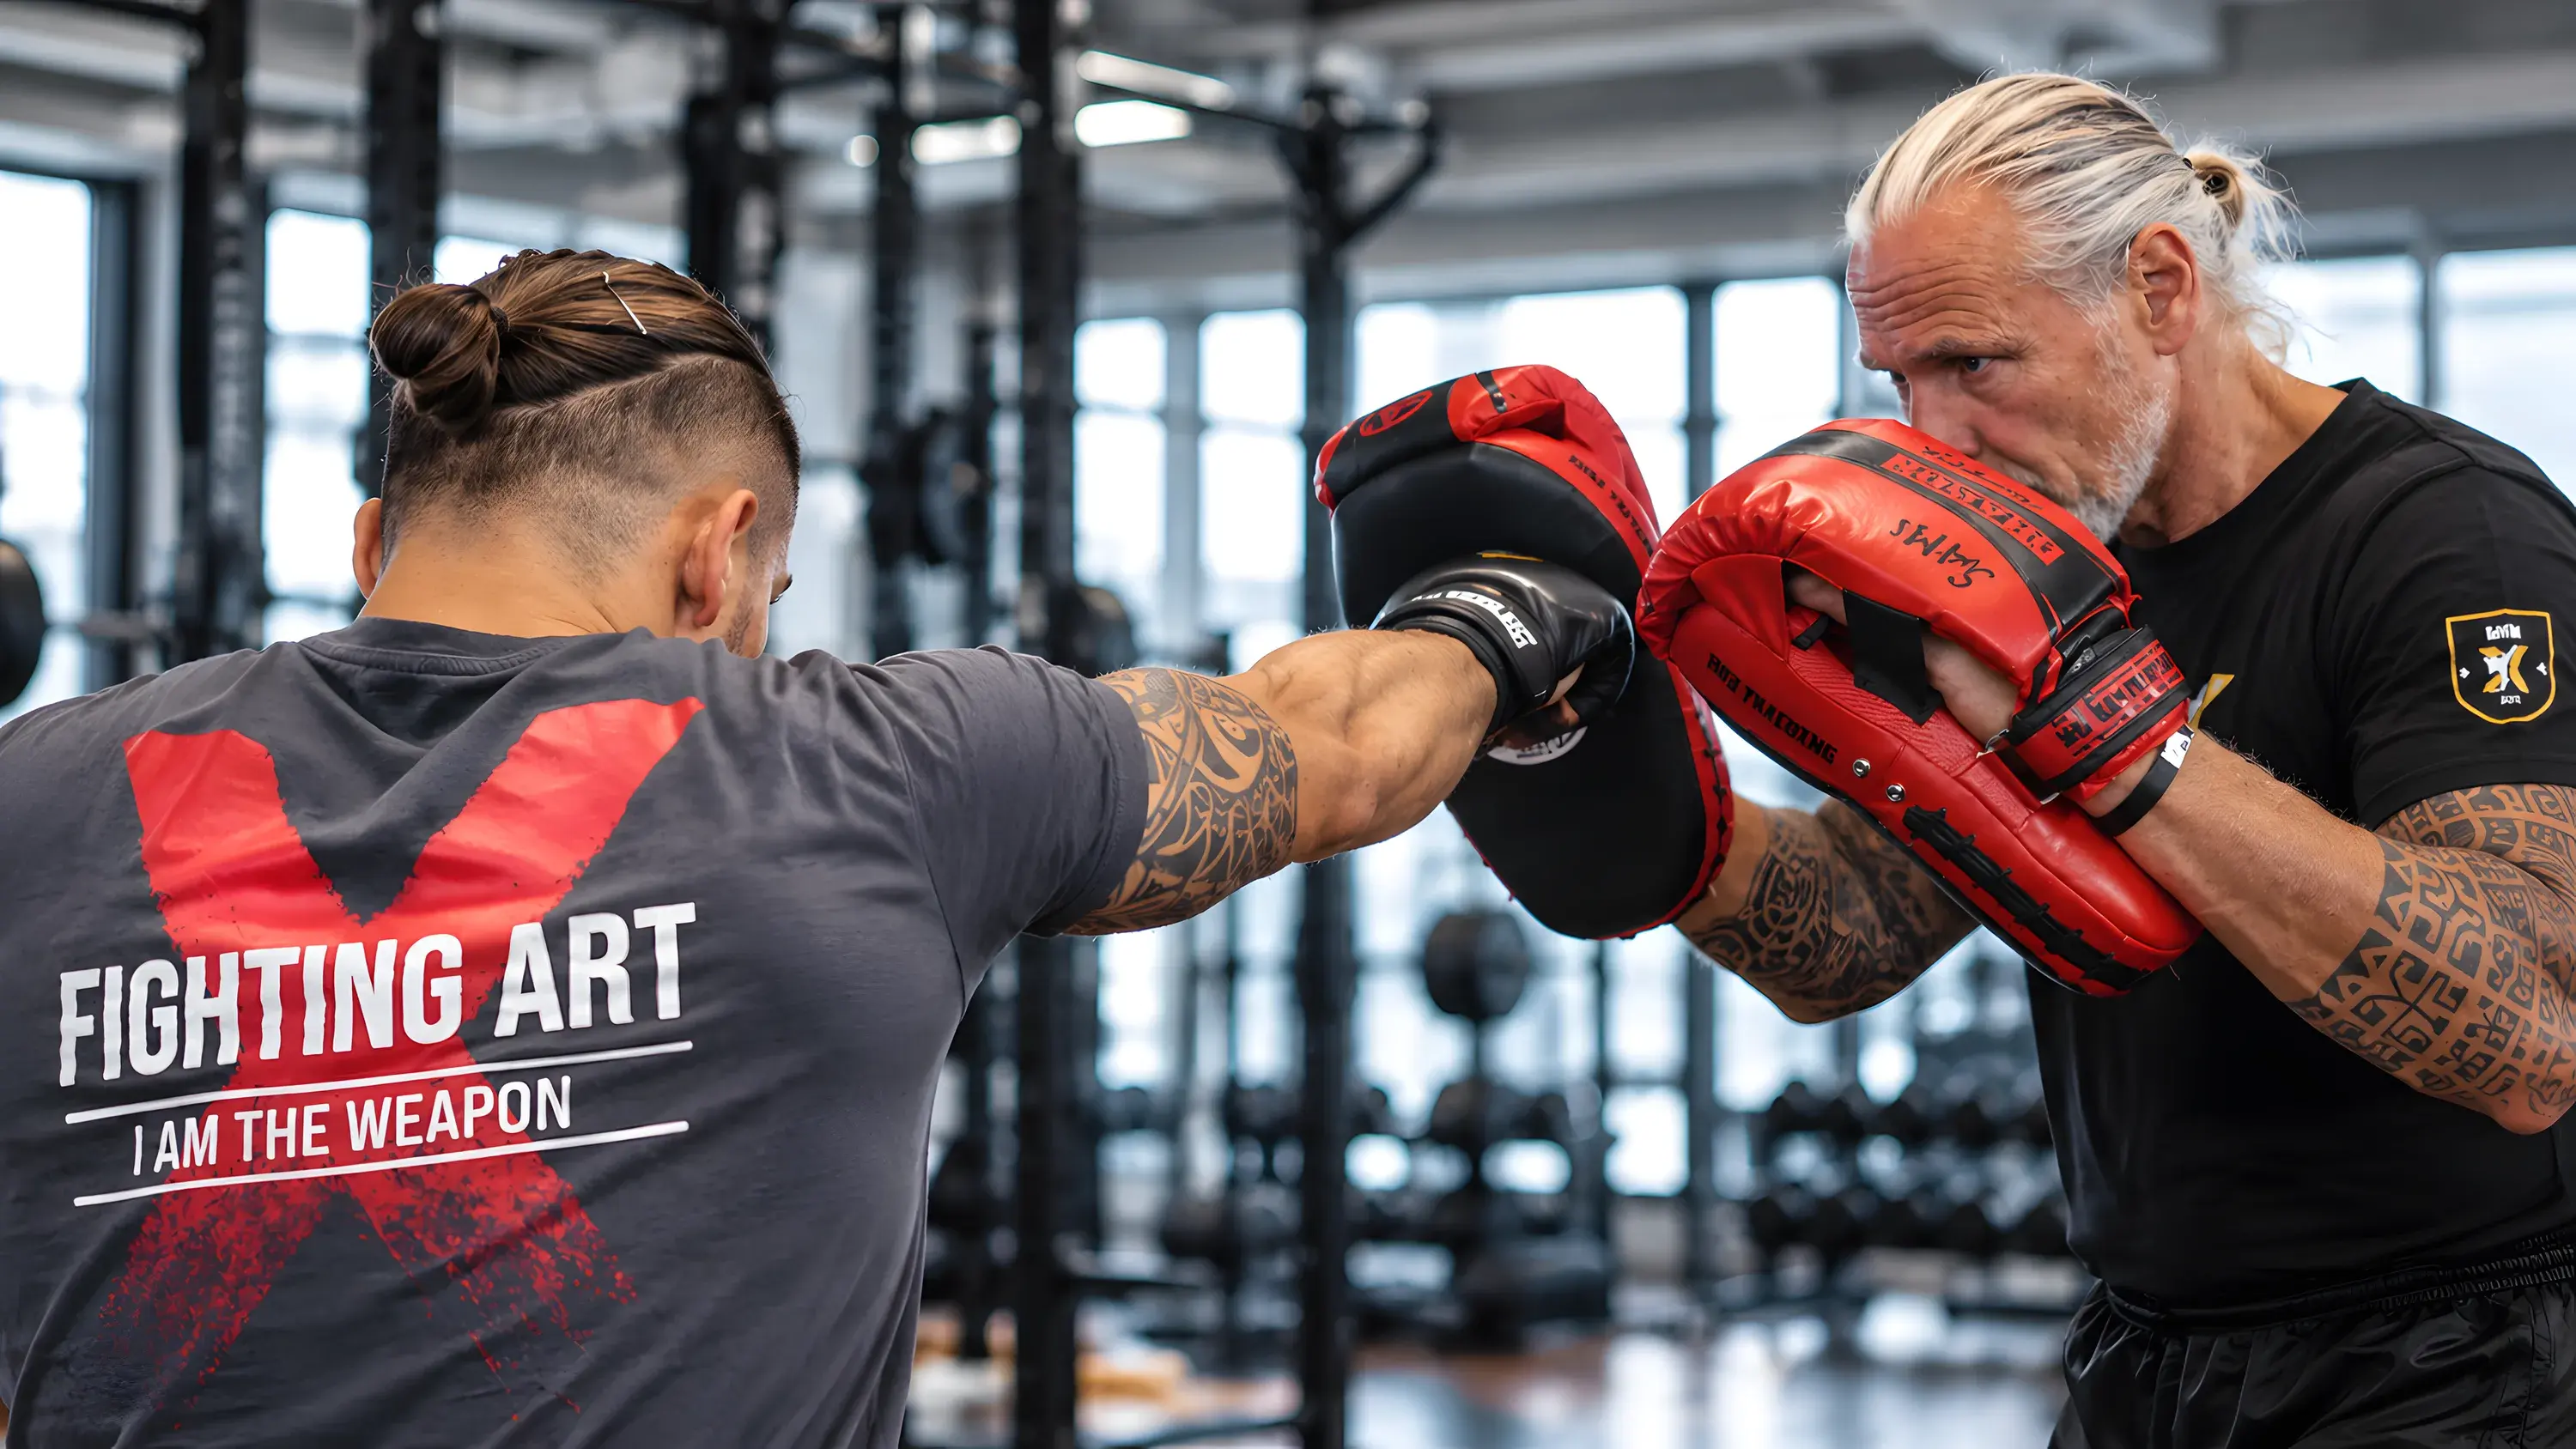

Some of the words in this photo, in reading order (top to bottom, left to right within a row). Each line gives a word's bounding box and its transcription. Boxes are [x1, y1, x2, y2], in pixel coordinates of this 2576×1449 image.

[59, 933, 463, 1087] FIGHTING
[494, 902, 696, 1038] ART
[133, 1125, 143, 1176] I
[153, 1114, 219, 1173] AM
[234, 1103, 331, 1162] THE
[345, 1075, 571, 1151] WEAPON
